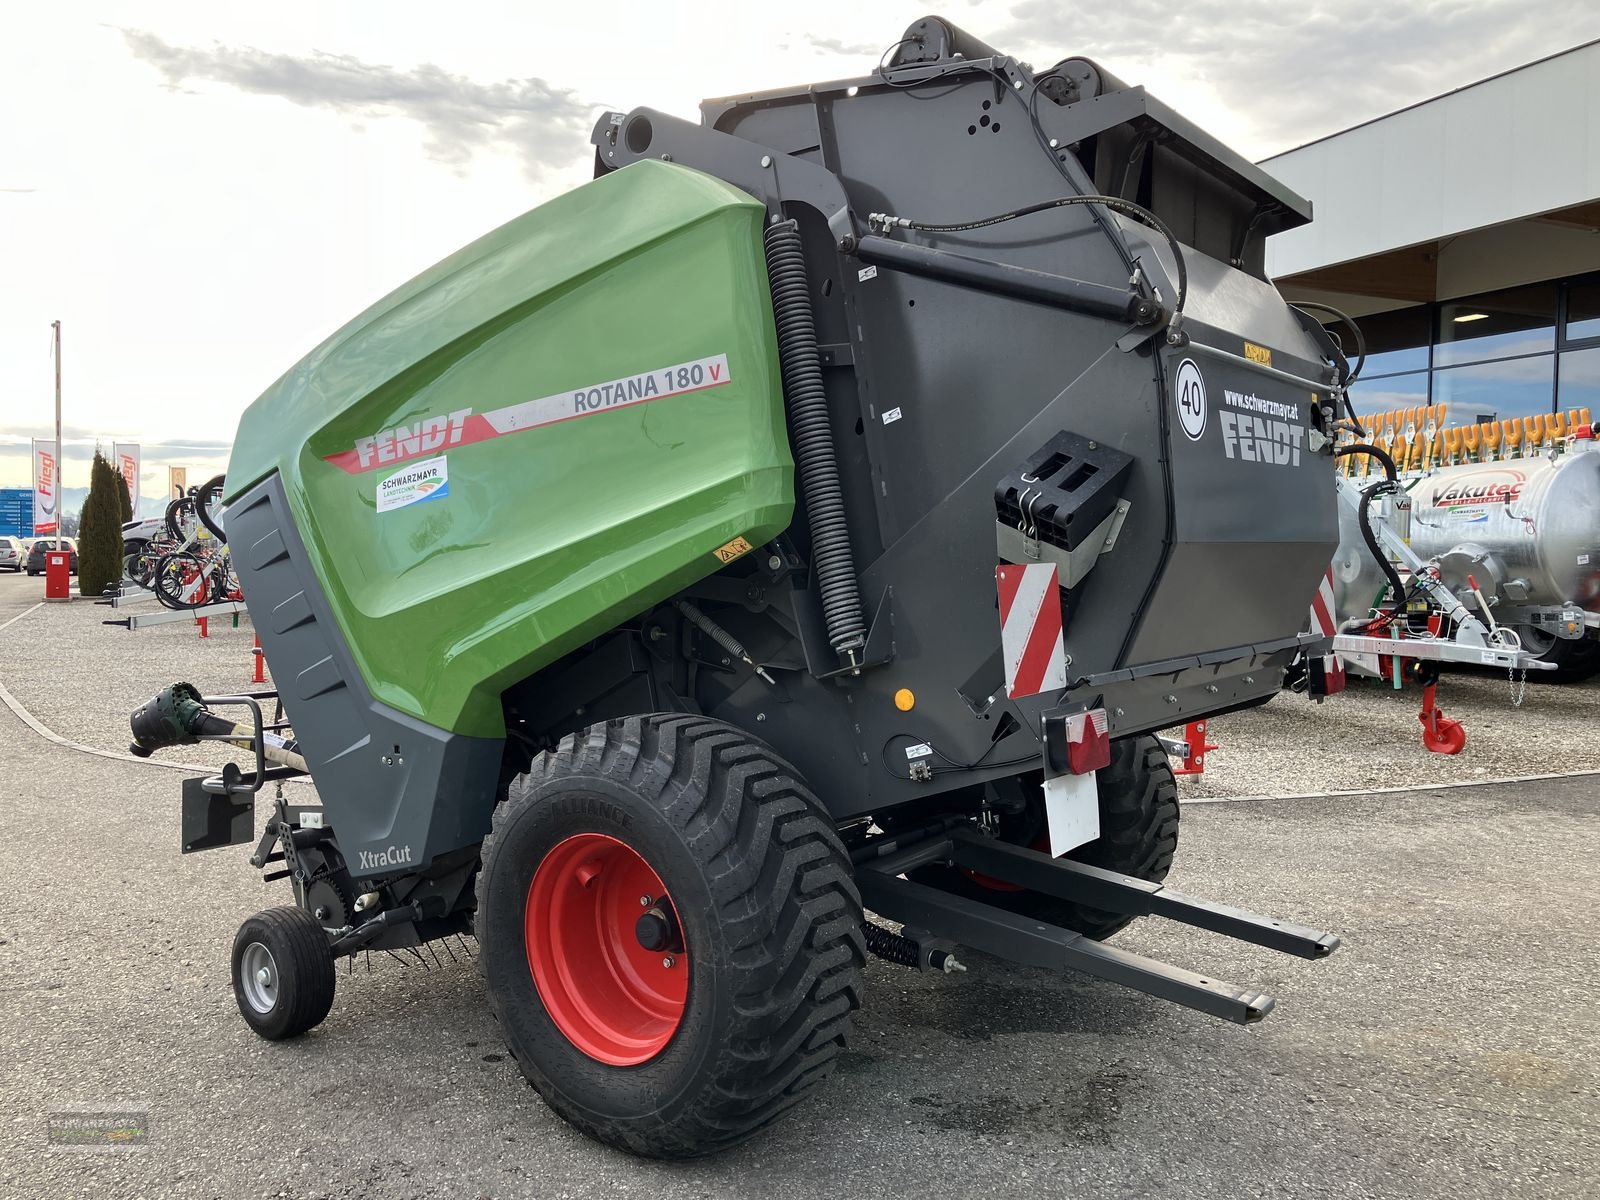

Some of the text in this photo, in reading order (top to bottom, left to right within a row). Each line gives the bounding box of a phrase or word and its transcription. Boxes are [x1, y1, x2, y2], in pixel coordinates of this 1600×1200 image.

[574, 363, 721, 413] ROTANA 180 V
[1181, 380, 1201, 416] 40
[1224, 389, 1299, 421] www.schwarzmayr.at
[355, 407, 472, 468] FENDT
[1219, 409, 1304, 467] FENDT
[38, 451, 55, 496] Fliegl
[382, 468, 437, 490] SCHWARZMAYR
[1432, 482, 1521, 507] Vakutec
[359, 845, 411, 870] XtraCut
